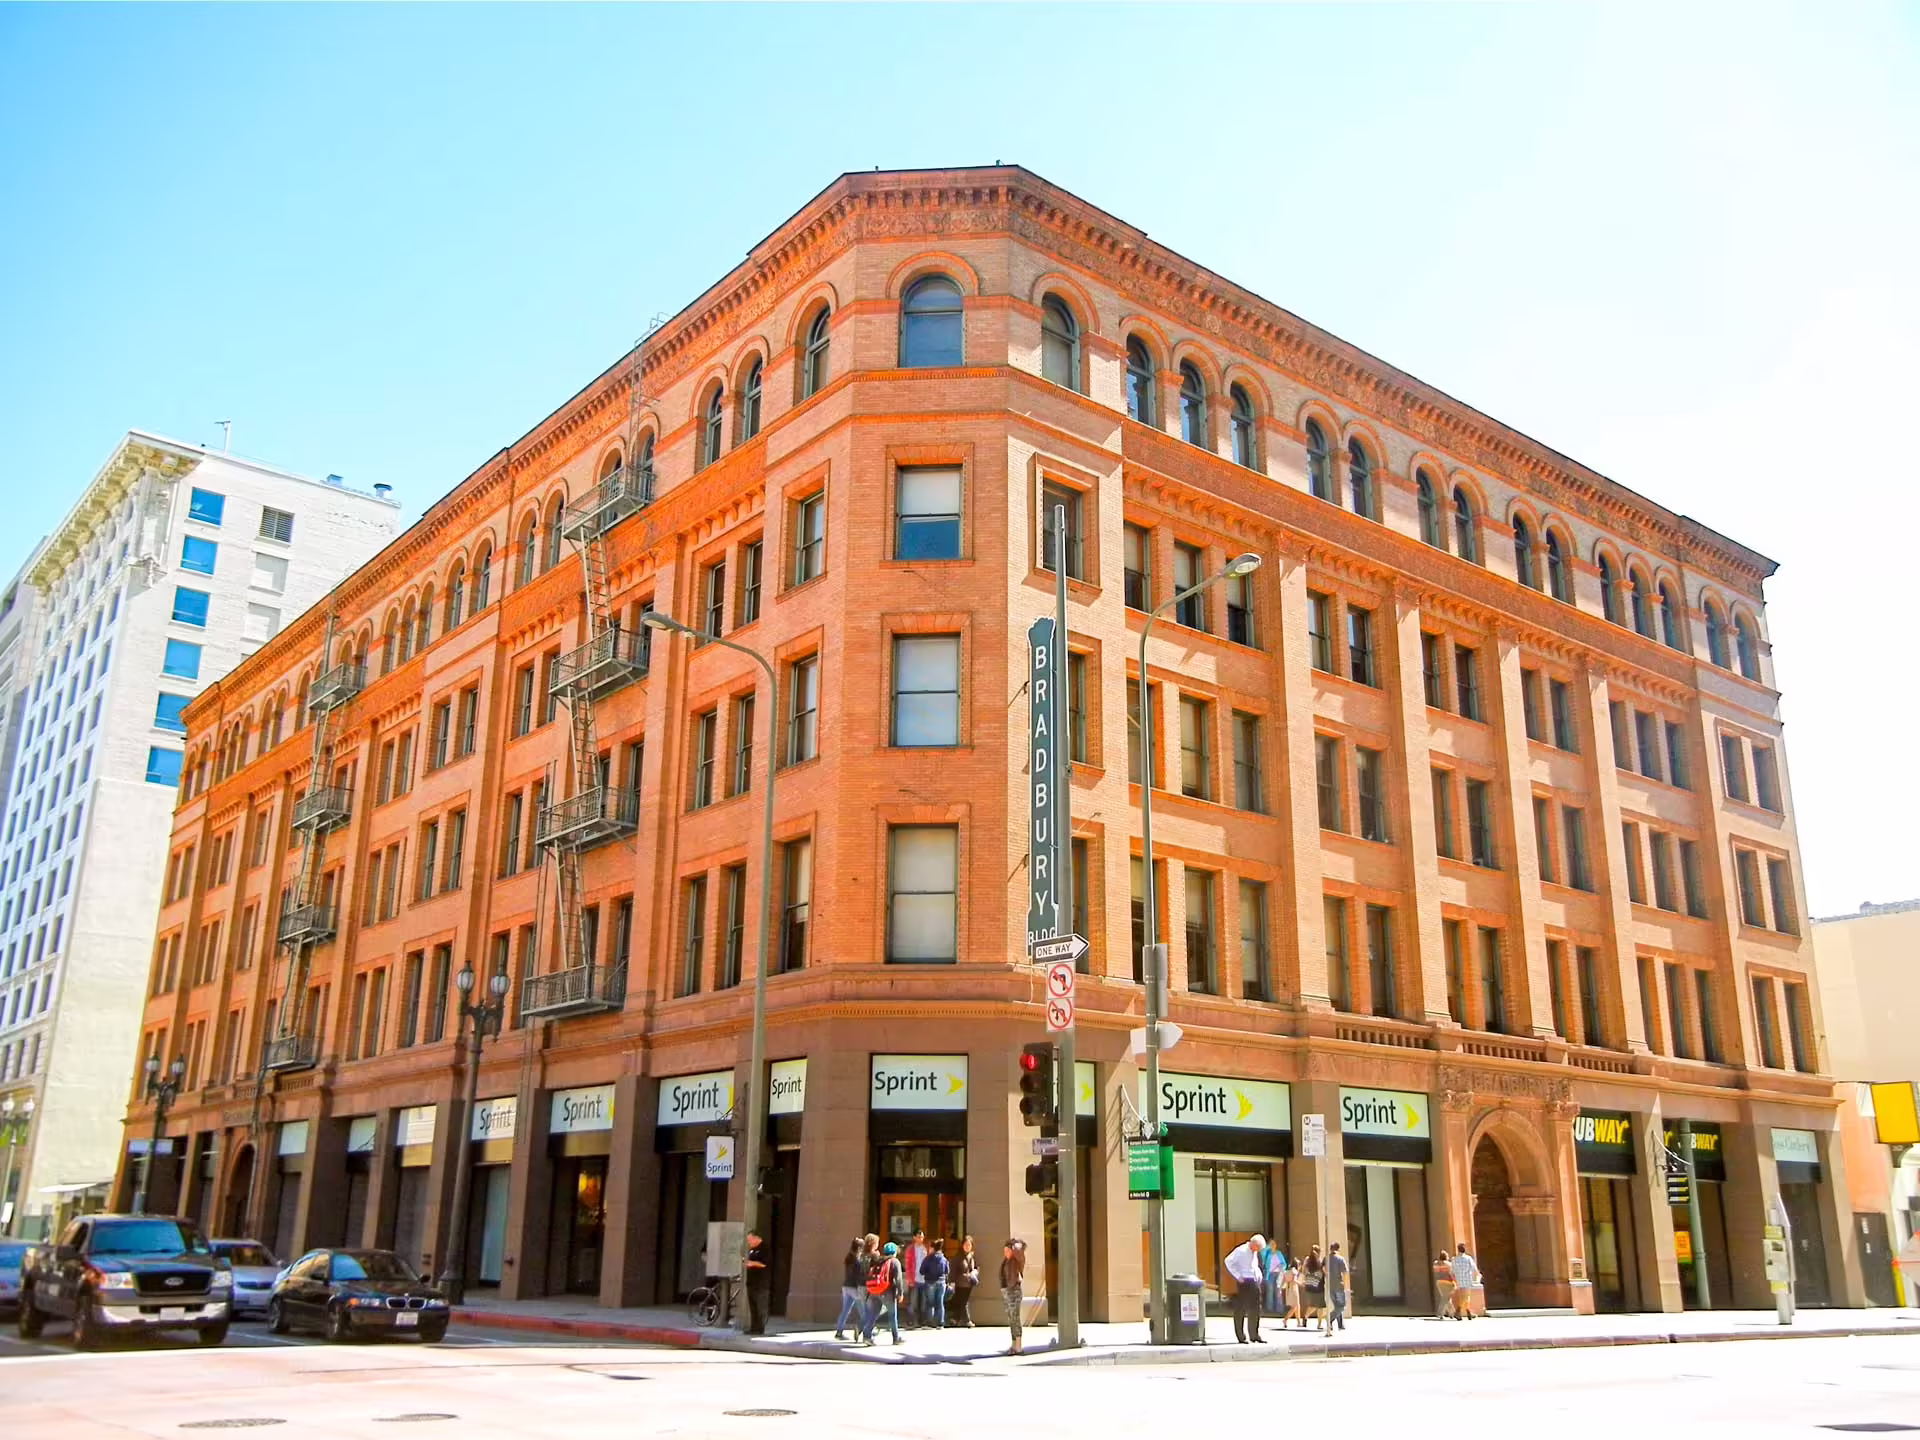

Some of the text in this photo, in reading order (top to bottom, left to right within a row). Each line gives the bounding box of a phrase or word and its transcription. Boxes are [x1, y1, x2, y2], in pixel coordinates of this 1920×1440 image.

[1035, 645, 1048, 916] BRADBURY
[1037, 943, 1071, 957] ONE WAY
[772, 1076, 802, 1099] Sprint
[875, 1071, 937, 1096] Sprint
[563, 1094, 602, 1127] Sprint
[672, 1081, 719, 1119] Sprint
[1162, 1082, 1227, 1119] Sprint
[1343, 1096, 1397, 1130] Sprint
[479, 1104, 512, 1135] Sprint
[1574, 1116, 1629, 1144] UBWAY
[707, 1162, 732, 1174] Sprint
[918, 1168, 937, 1178] 300
